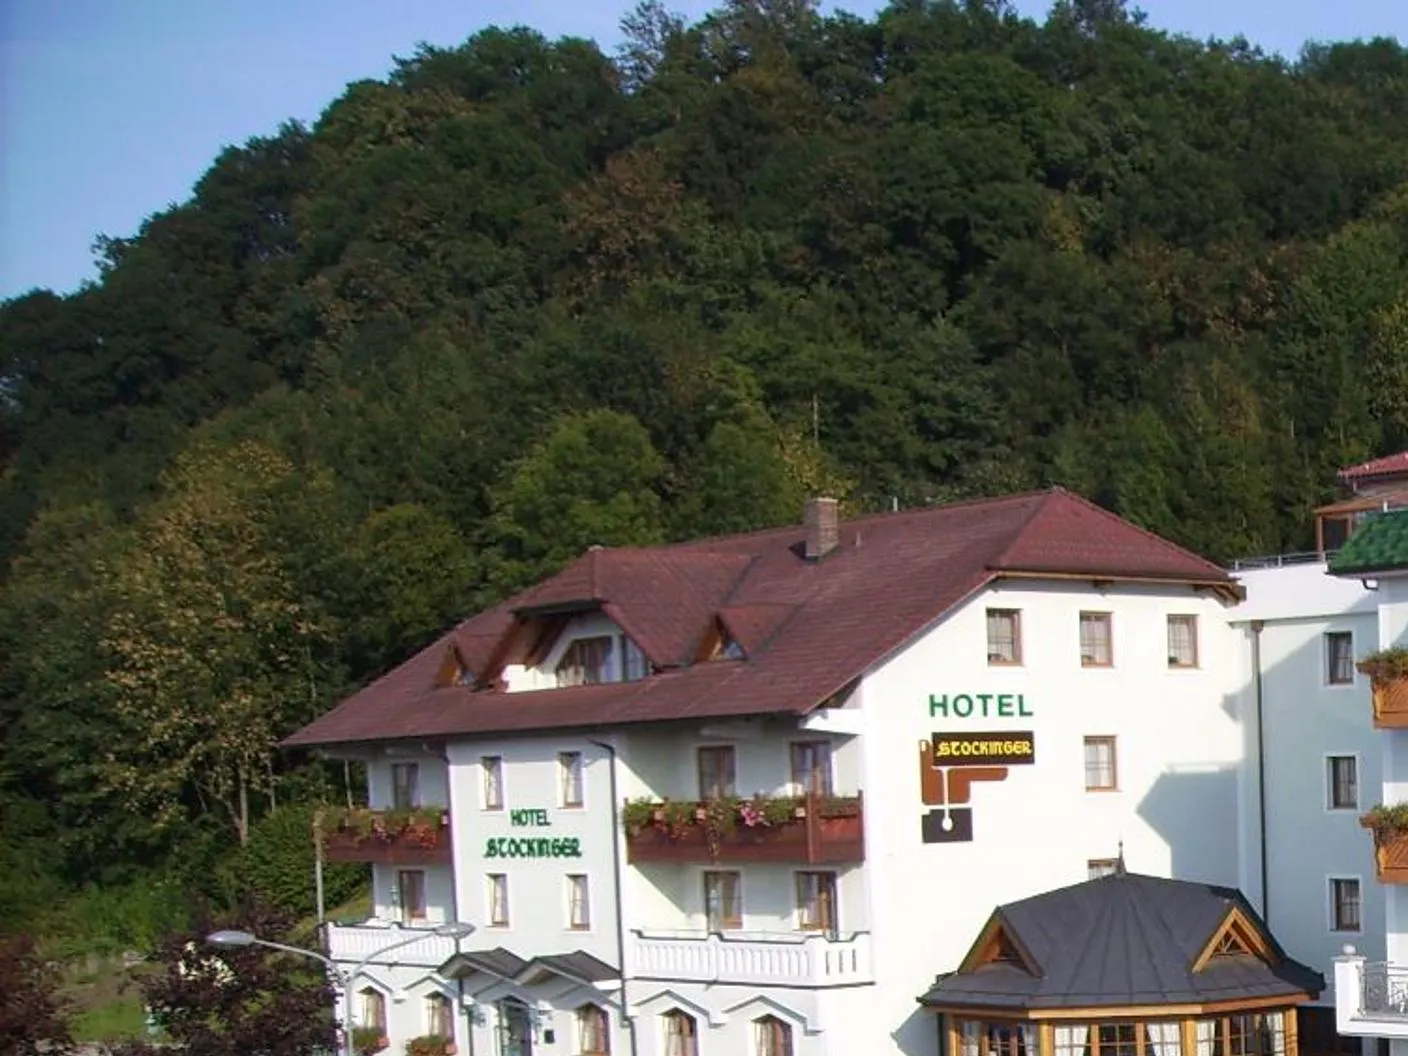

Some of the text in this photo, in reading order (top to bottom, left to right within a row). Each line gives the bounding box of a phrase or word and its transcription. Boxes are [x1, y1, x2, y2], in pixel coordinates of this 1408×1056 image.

[928, 693, 1034, 718] HOTEL
[936, 740, 1033, 757] STOCKINGER
[510, 808, 552, 827] HOTEL
